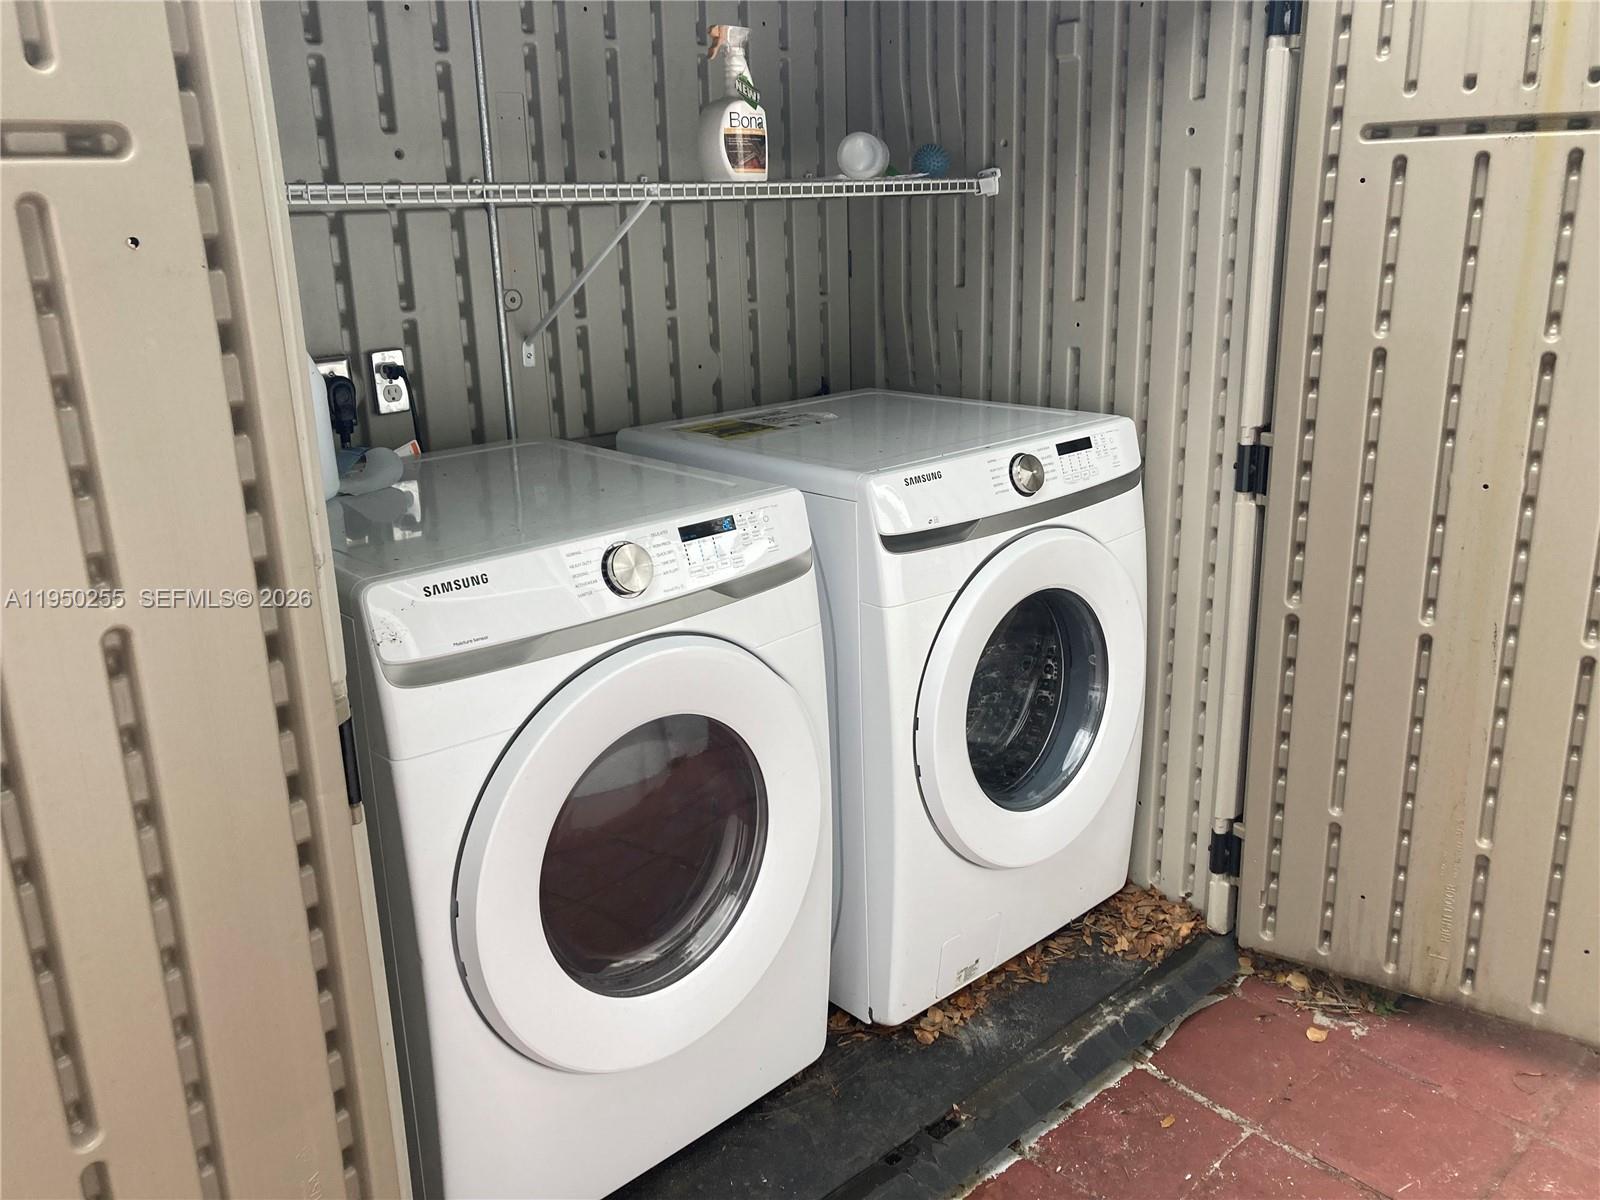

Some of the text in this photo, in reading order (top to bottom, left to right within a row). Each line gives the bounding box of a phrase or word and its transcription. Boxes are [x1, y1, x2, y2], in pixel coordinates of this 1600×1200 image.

[735, 79, 760, 102] NEW!
[729, 111, 764, 129] Bona
[903, 470, 943, 487] SAMSUNG
[423, 573, 489, 597] SAMSUNG
